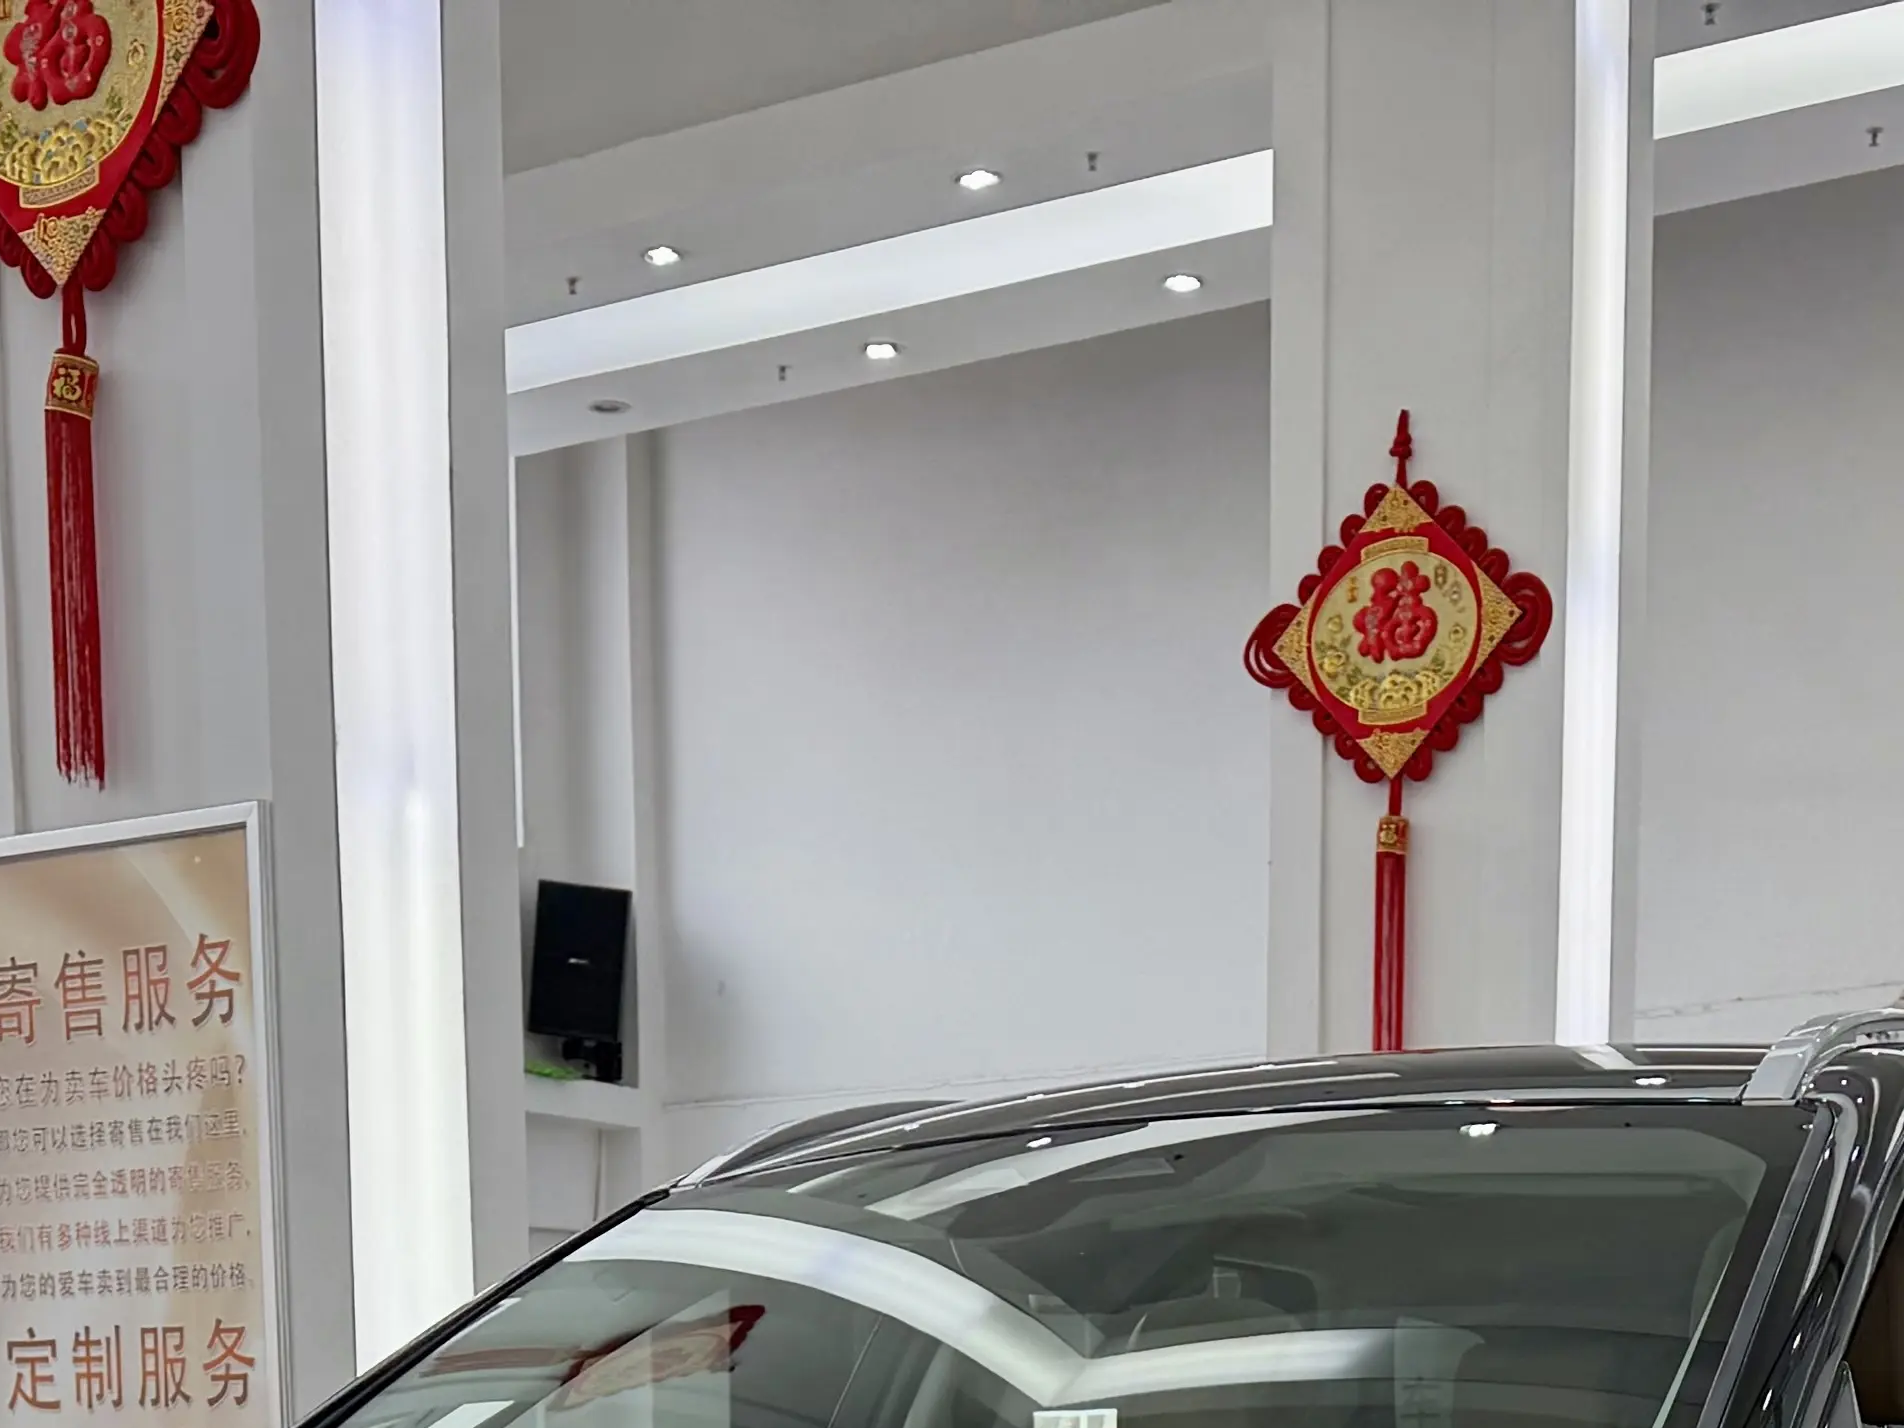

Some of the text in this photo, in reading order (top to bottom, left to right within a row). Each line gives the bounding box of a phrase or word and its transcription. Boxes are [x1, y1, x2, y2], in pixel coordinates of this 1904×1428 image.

[1353, 561, 1438, 663] 福
[6, 1318, 256, 1412] 定制服务
